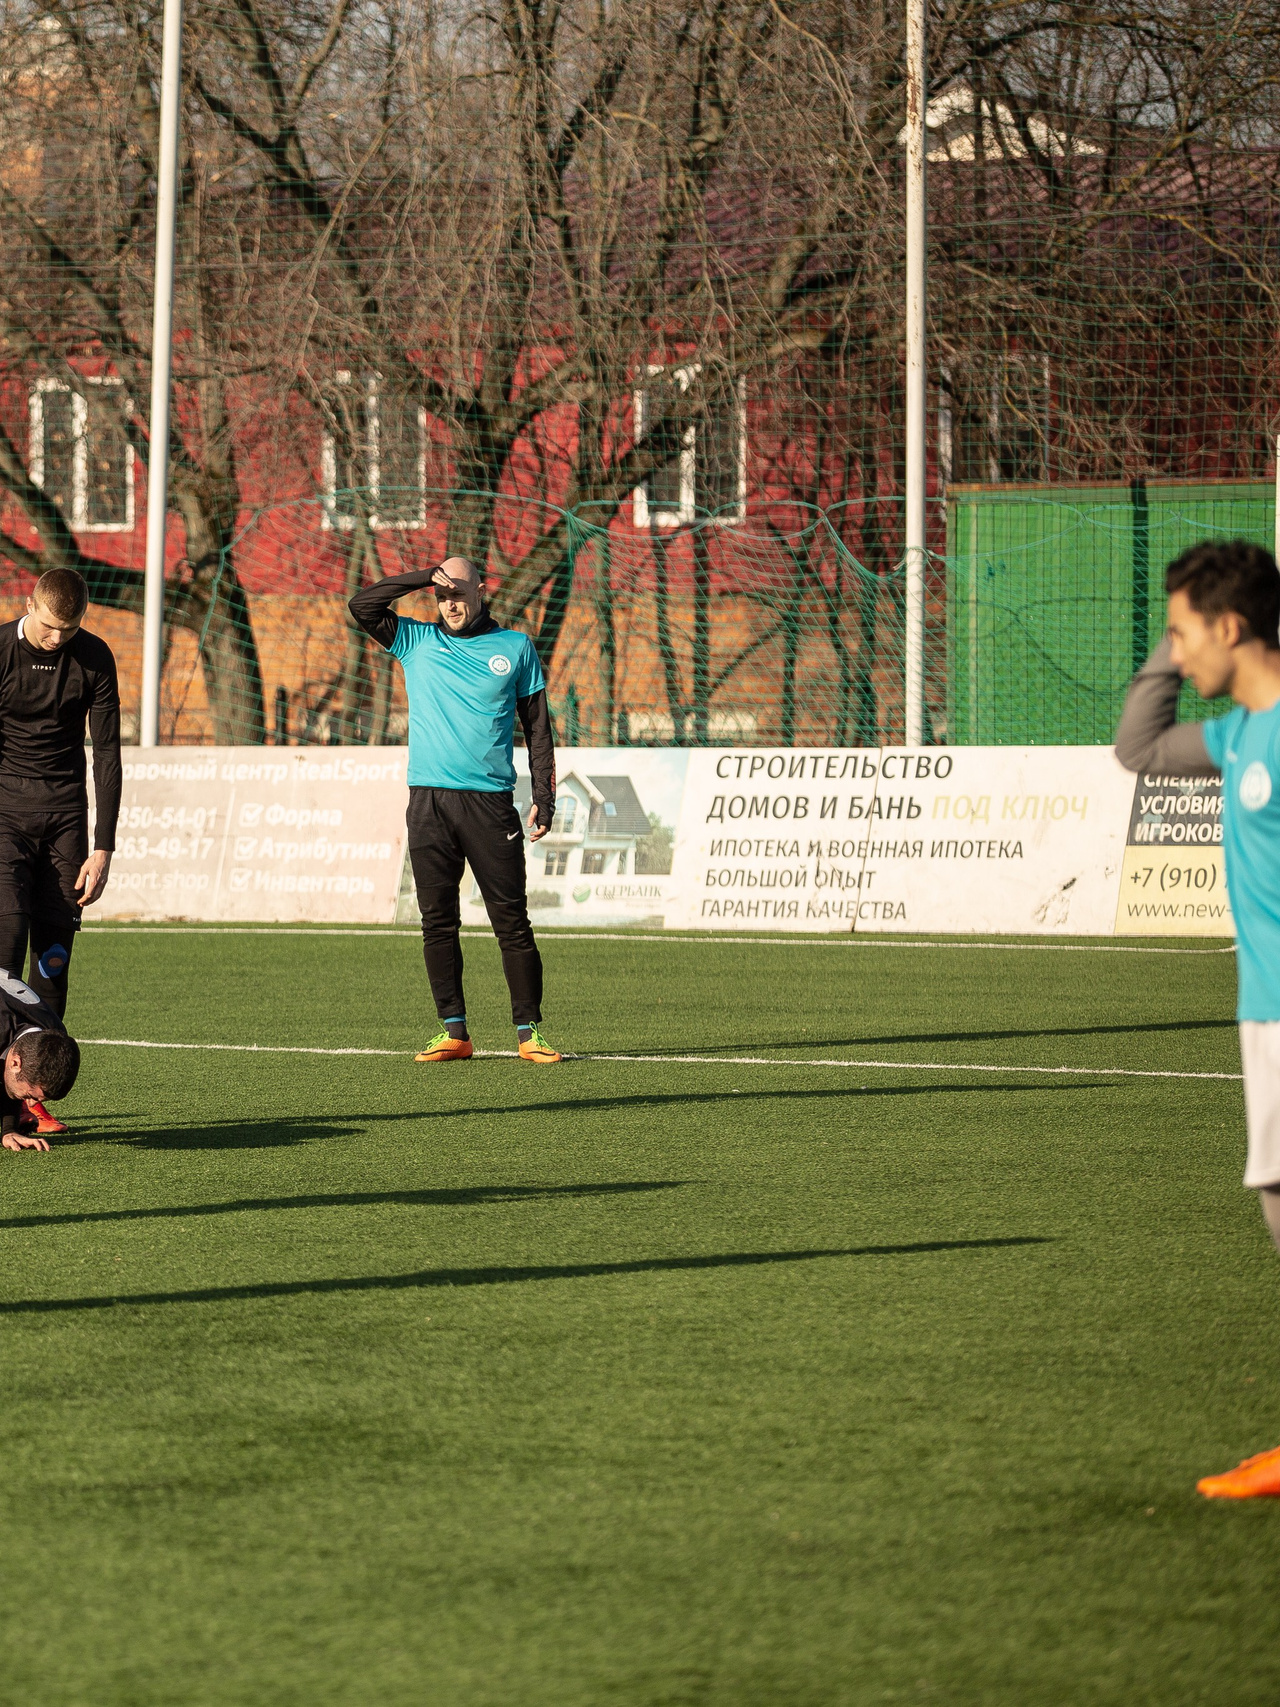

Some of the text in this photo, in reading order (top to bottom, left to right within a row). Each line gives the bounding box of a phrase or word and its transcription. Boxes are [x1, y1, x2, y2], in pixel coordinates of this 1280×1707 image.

[121, 758, 217, 782] овочный
[221, 763, 288, 785] центр
[715, 755, 954, 780] СТРОИТЕЛЬСТВО
[118, 806, 218, 830] 350-54-01
[265, 803, 343, 830] Форма
[706, 795, 1089, 825] ДОМОВ И БАНЬ ПОД КЛЮЧ
[1134, 822, 1224, 842] ИГРОКОВ
[257, 836, 391, 864] Атрибутика
[709, 839, 800, 858] ИПОТЕКА
[827, 839, 923, 858] ВОЕННАЯ
[930, 840, 1024, 859] ИПОТЕКА
[108, 870, 211, 892] sport.shop
[252, 869, 375, 894] Инвентарь
[705, 864, 877, 889] БОЛЬШОЙ ОПЫТ
[1130, 863, 1217, 892] +7 (910)
[701, 899, 907, 919] ГАРАНТИЯ КАЧЕСТВА
[1127, 903, 1232, 918] www.new-
